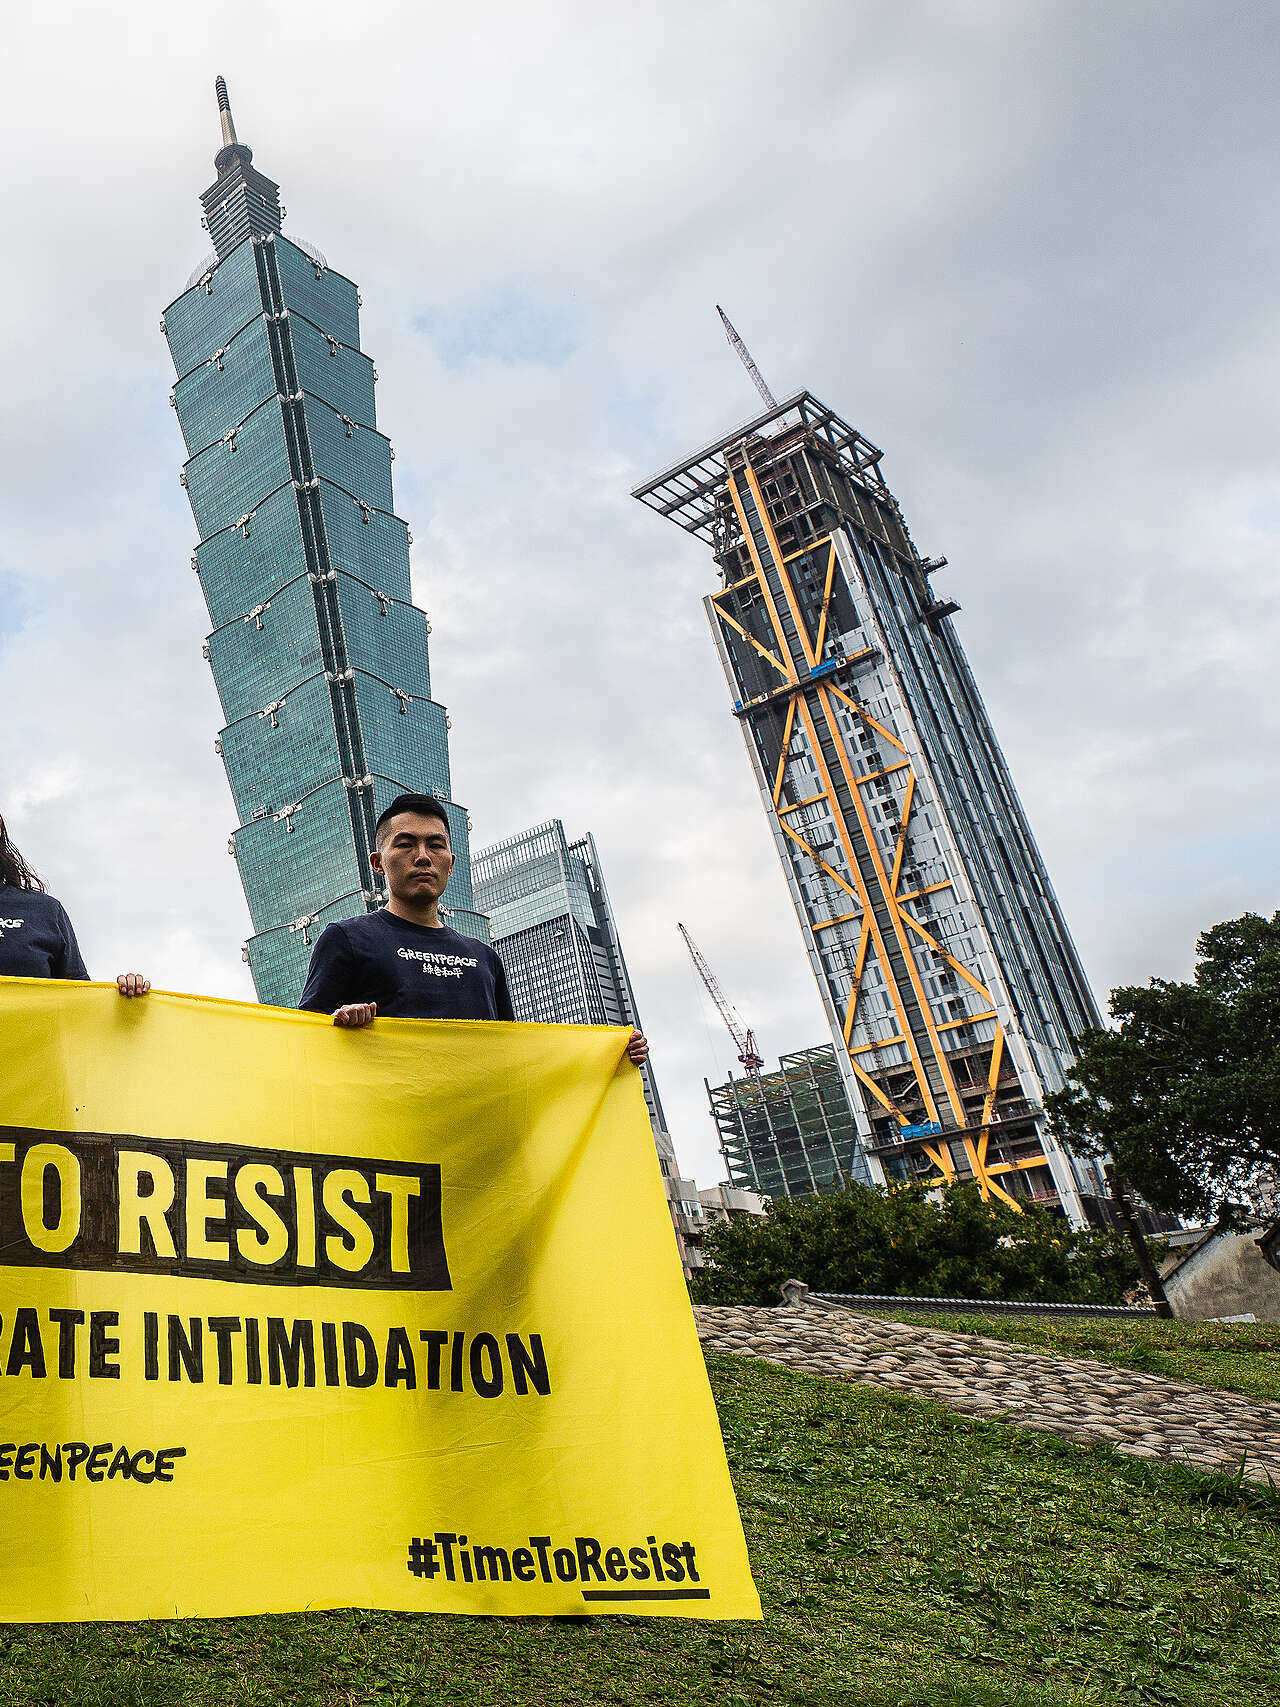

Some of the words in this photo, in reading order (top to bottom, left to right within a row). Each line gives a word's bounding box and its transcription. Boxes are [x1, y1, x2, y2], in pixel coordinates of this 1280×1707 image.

[396, 947, 478, 968] GREENPEACE
[422, 962, 463, 978] 綠色和平
[117, 1150, 421, 1273] RESIST
[143, 1311, 552, 1399] INTIMIDATION
[407, 1532, 701, 1583] #TimeToResist
